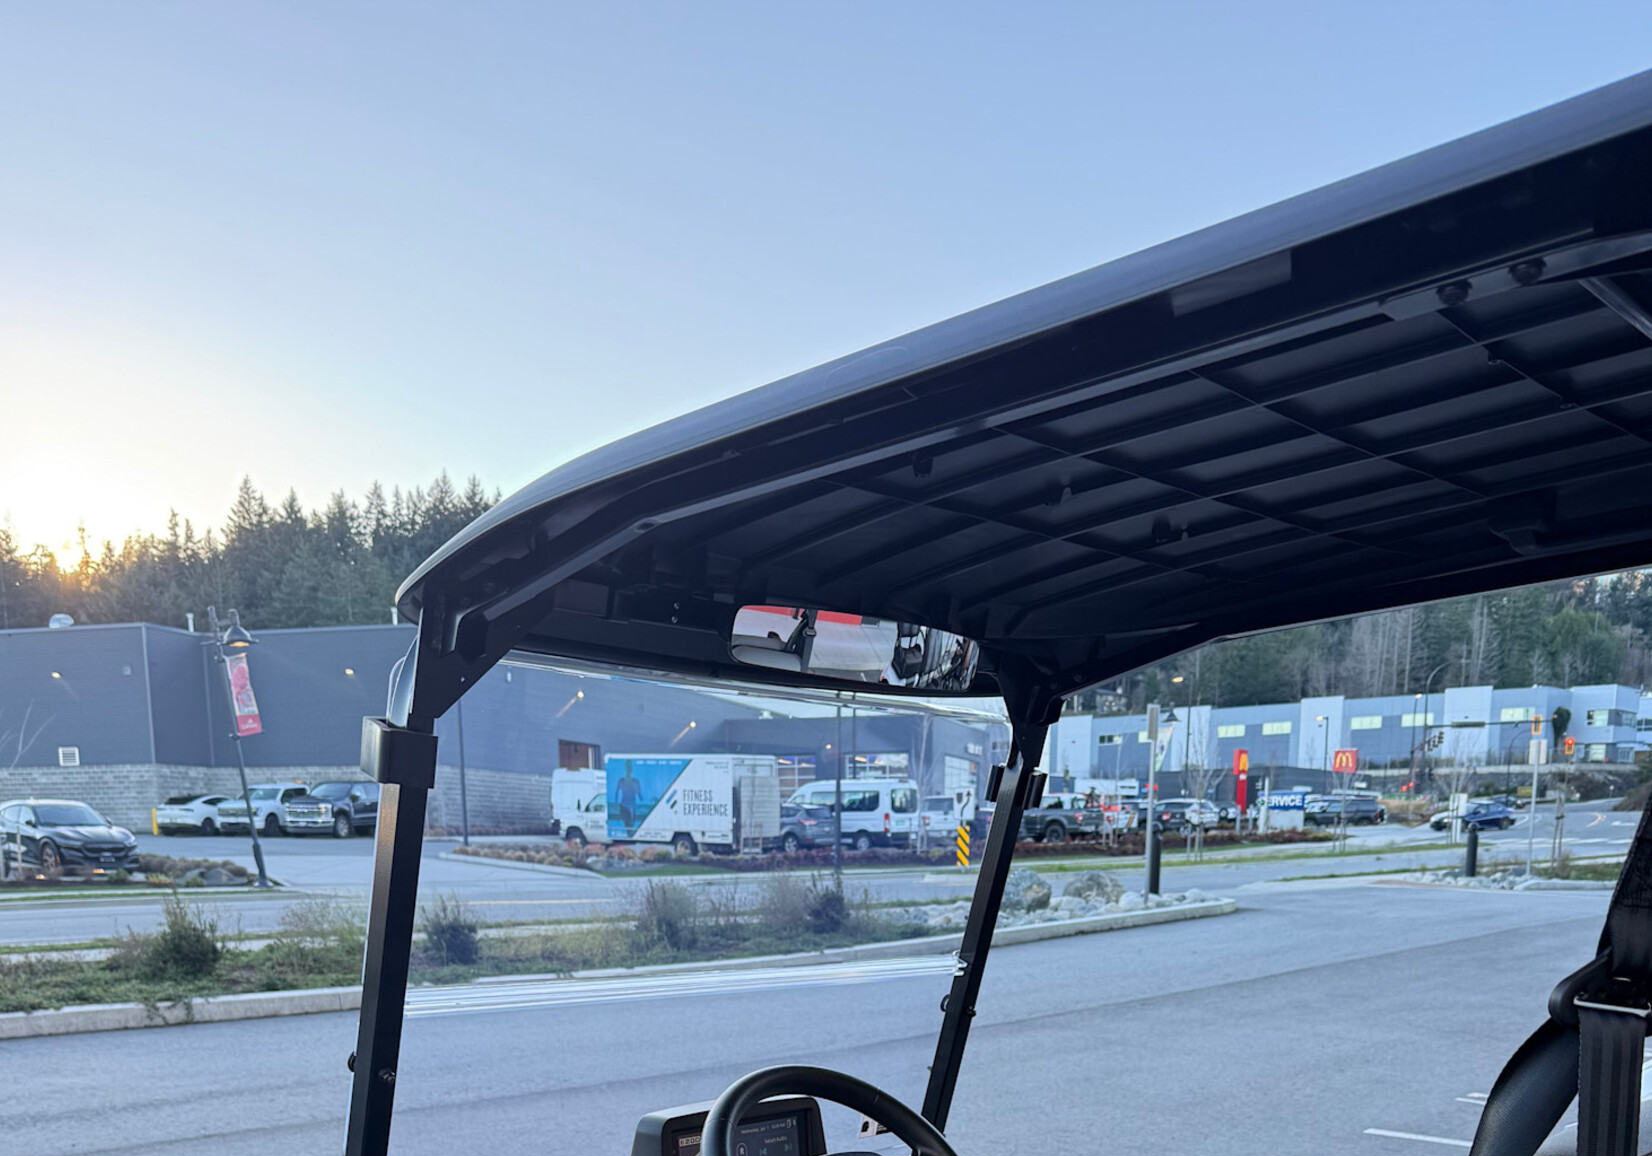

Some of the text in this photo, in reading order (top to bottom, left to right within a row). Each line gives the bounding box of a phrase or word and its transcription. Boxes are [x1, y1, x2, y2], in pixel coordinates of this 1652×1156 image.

[683, 789, 714, 802] FITNESS
[1268, 794, 1303, 807] ERVICE
[683, 803, 729, 817] EXPERIENCE
